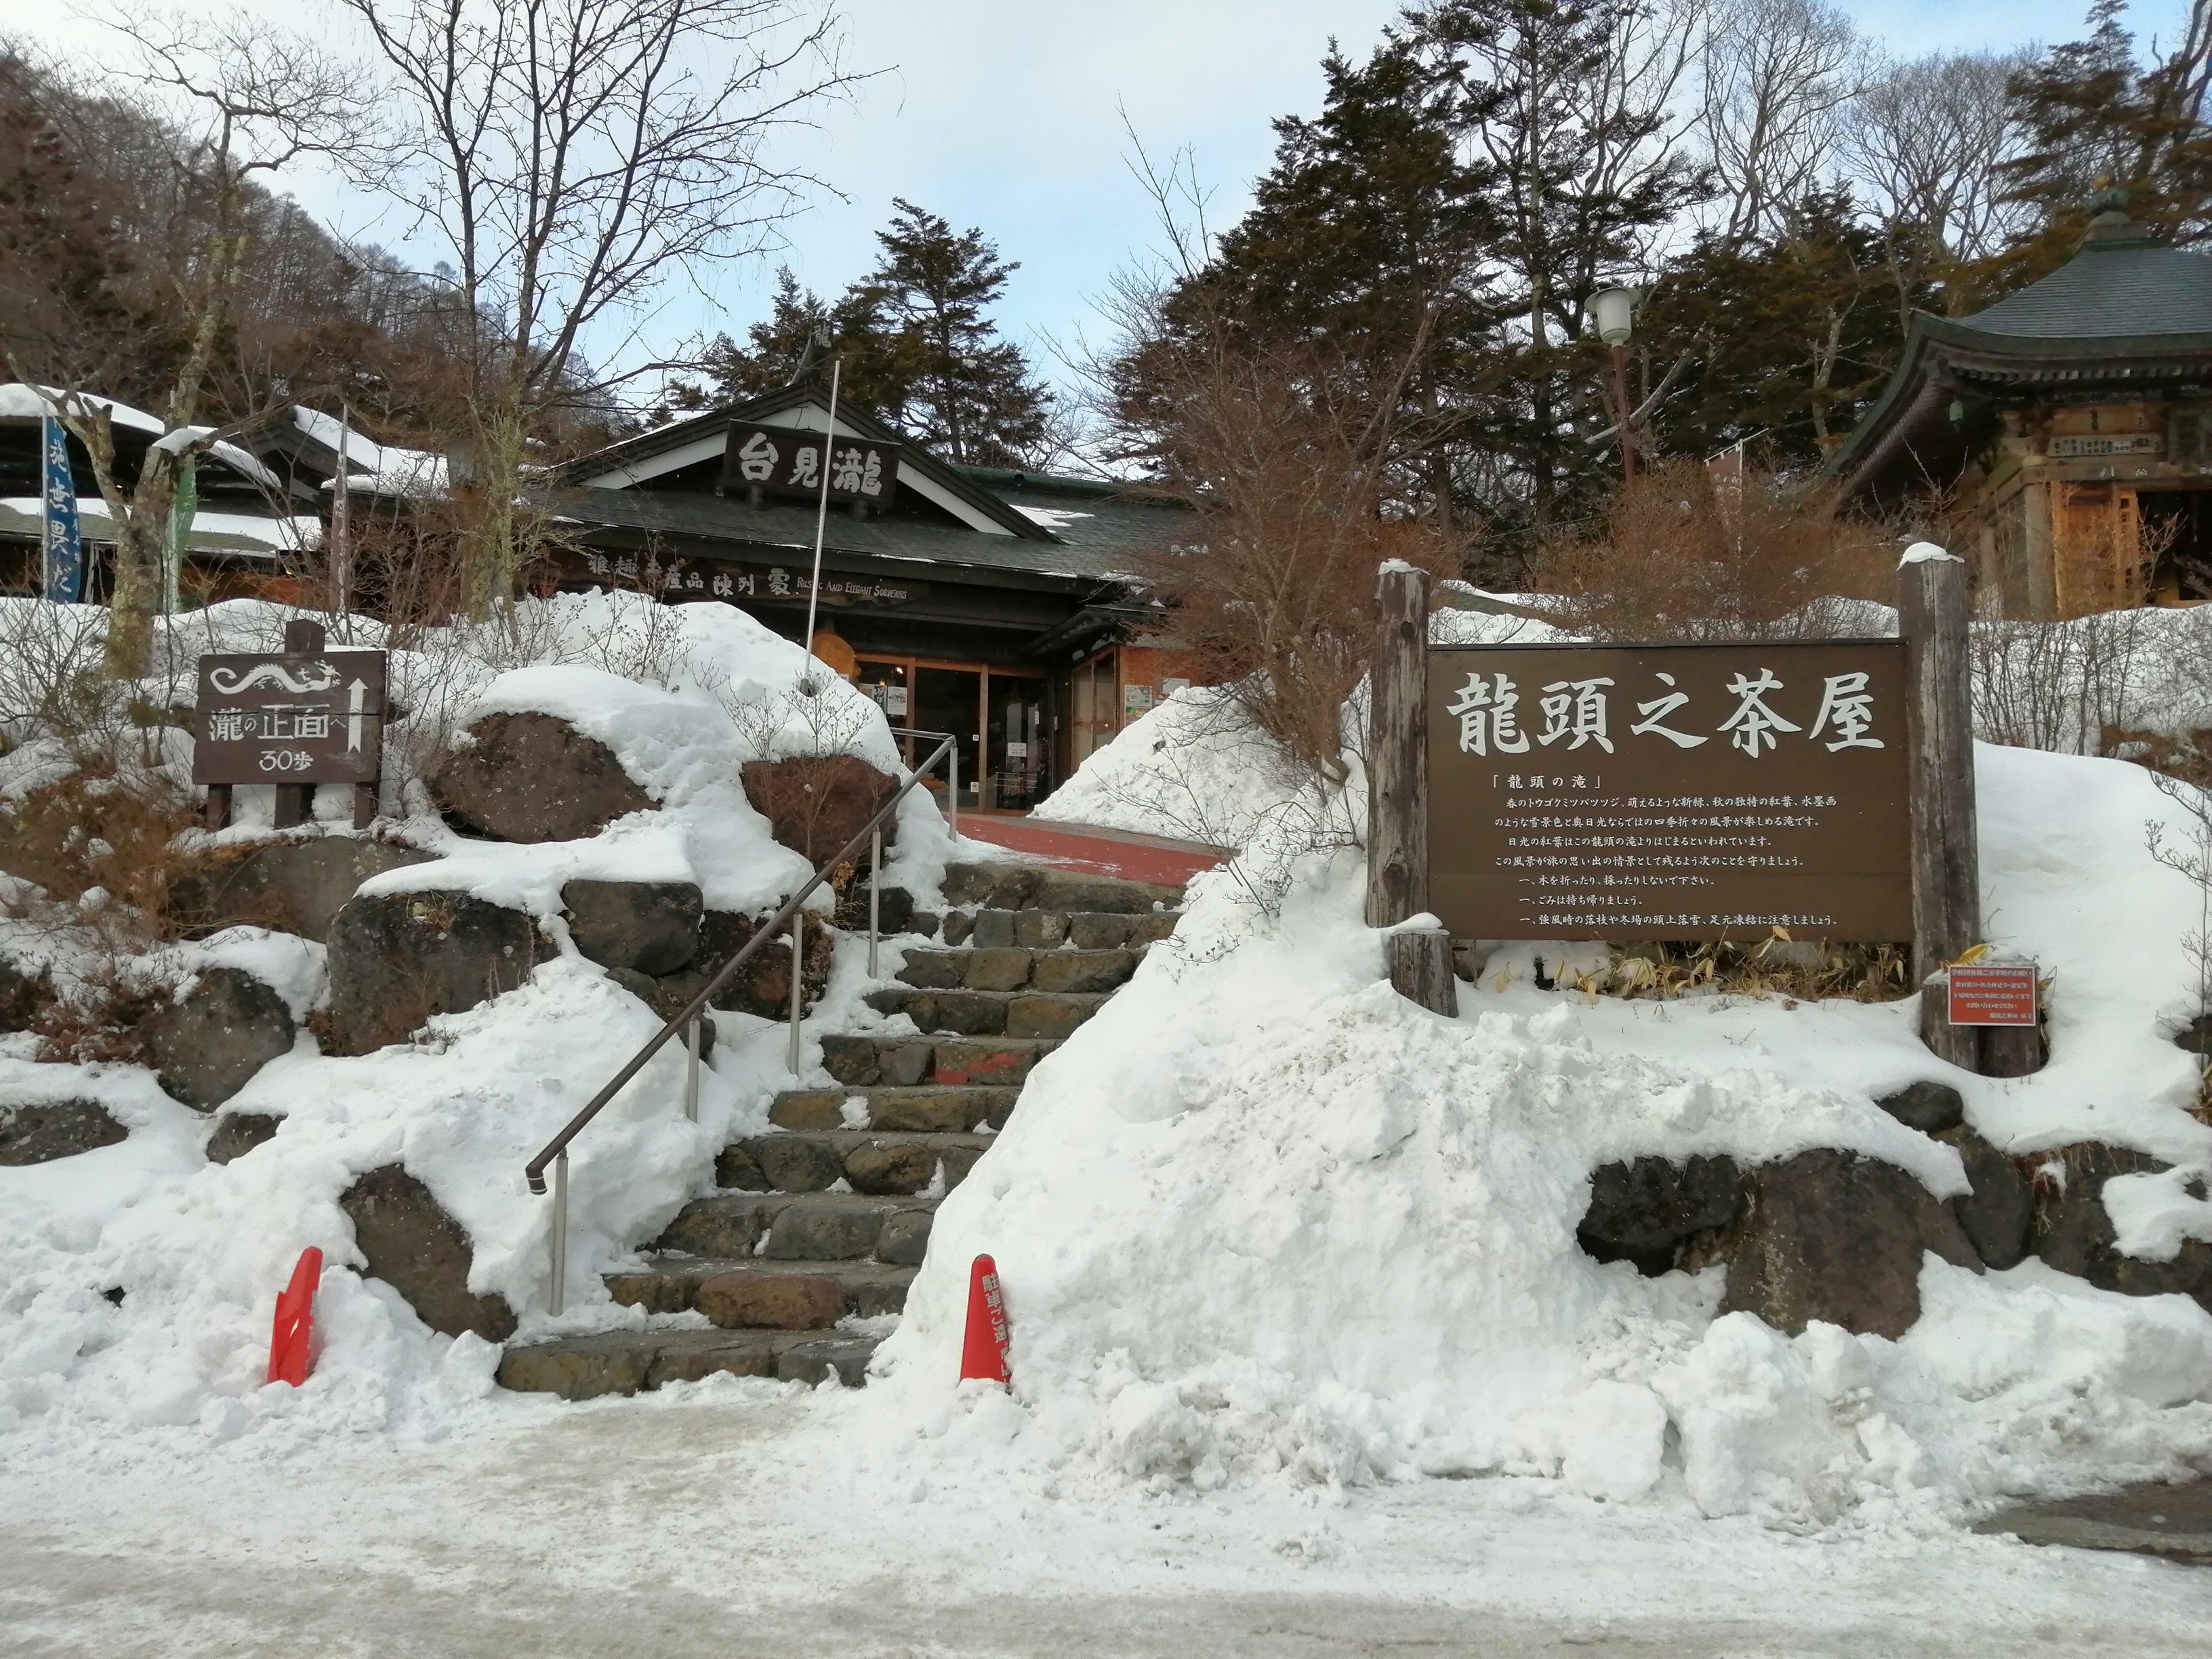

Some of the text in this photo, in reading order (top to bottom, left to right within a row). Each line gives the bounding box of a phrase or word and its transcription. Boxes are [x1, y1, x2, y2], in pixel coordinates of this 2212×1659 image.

[797, 576, 823, 590] RUSC
[826, 579, 843, 592] AND
[1446, 668, 1885, 758] 龍頭之茶屋
[260, 750, 314, 771] 30歩
[1494, 775, 1601, 790] 「龍頭の滝」
